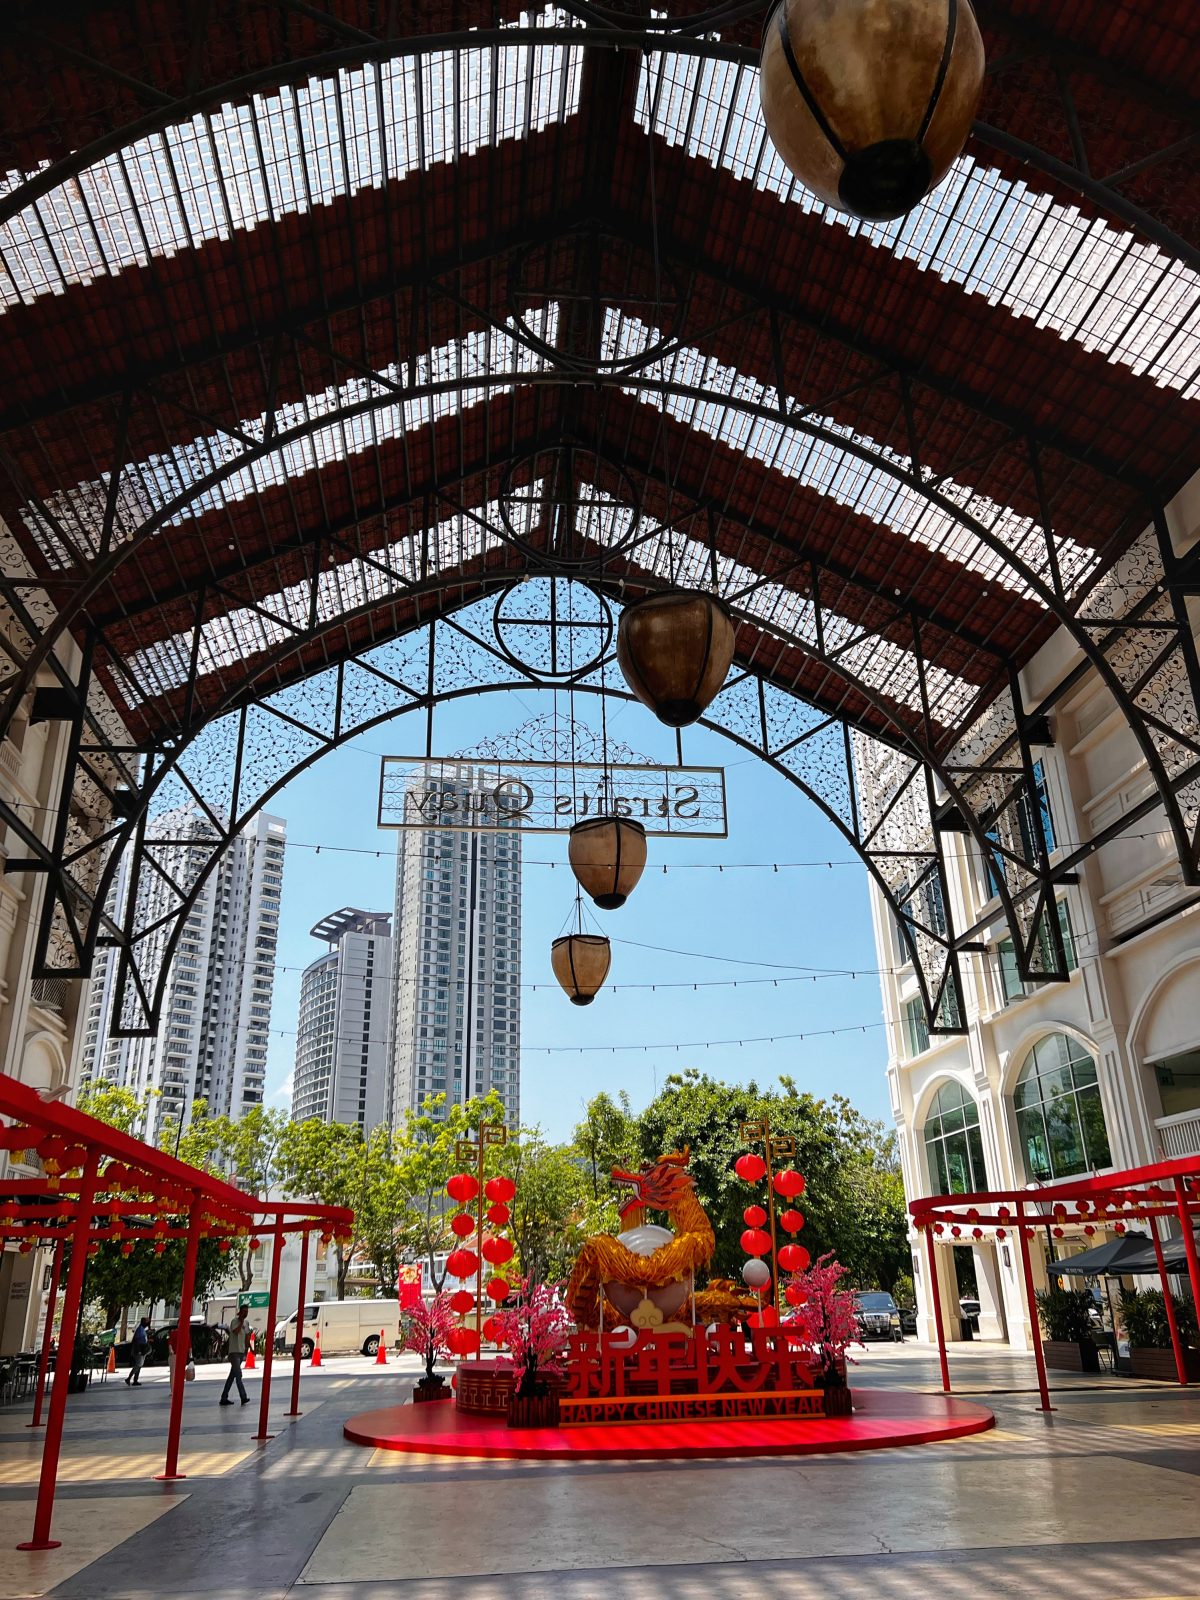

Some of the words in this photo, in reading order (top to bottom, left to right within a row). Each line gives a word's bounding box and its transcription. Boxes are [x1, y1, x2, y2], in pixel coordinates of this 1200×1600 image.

[566, 1323, 815, 1398] 新年快乐
[560, 1402, 628, 1424] HAPPY
[633, 1399, 717, 1421] CHINESE
[721, 1397, 766, 1418] NEW
[772, 1394, 824, 1416] YEAR
